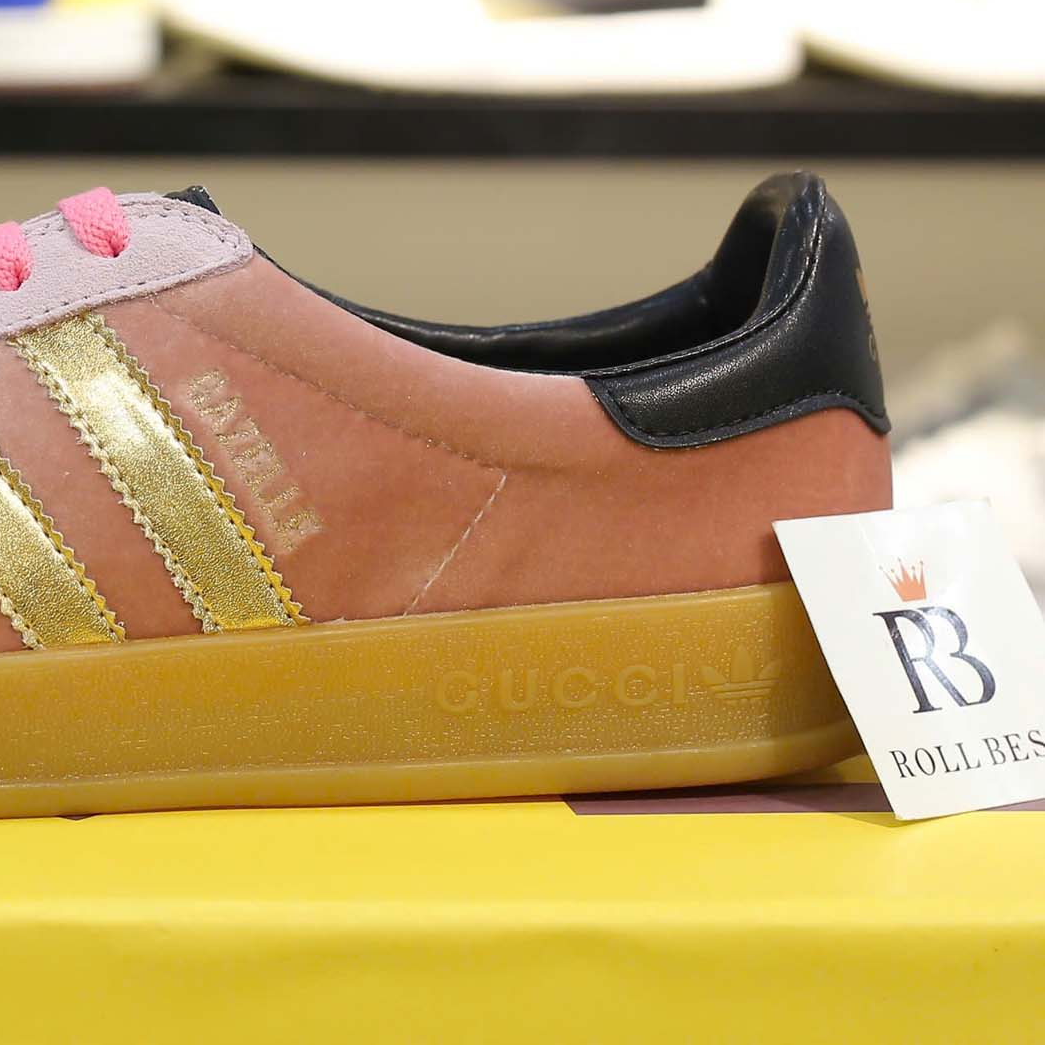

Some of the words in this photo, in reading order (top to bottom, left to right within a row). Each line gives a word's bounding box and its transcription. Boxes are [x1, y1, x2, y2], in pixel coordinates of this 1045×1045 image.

[187, 371, 322, 550] GAZELLE
[437, 664, 686, 712] GUCCI
[889, 742, 981, 778] ROLL
